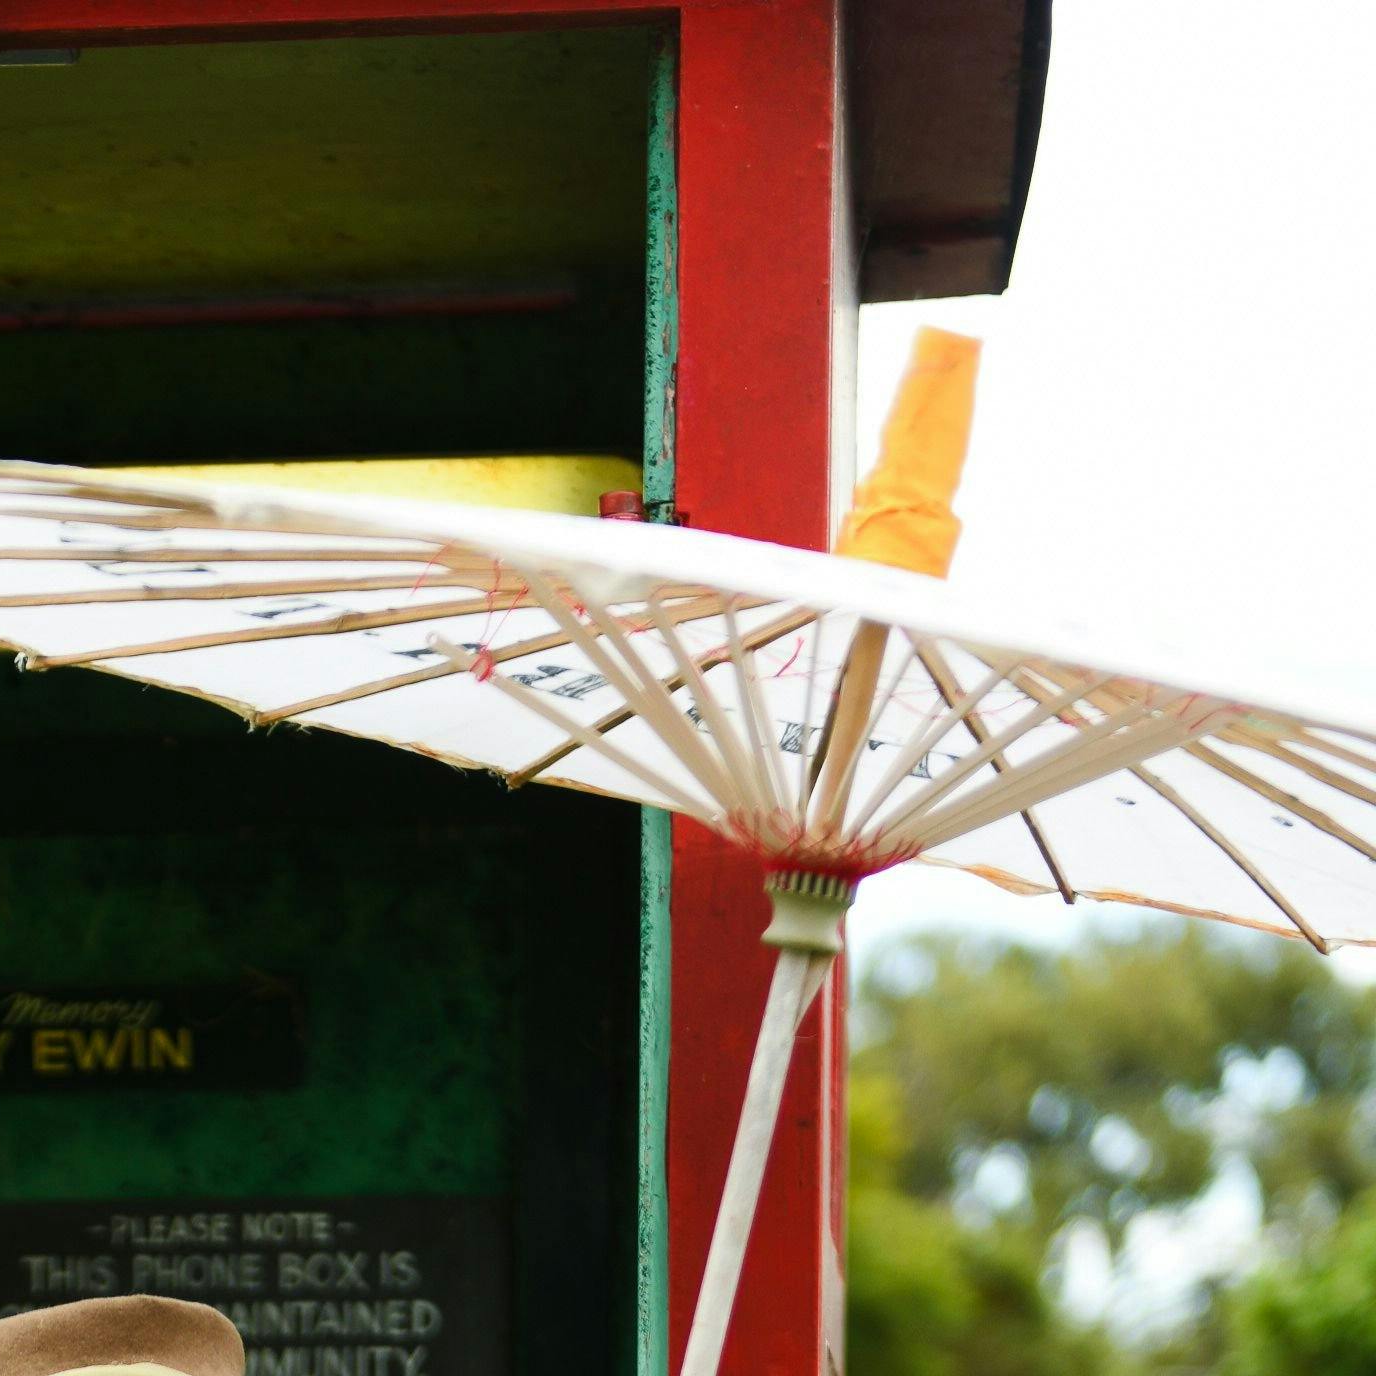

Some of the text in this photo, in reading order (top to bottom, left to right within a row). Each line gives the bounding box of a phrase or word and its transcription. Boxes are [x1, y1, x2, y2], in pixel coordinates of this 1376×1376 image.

[2, 992, 159, 1028] Memory
[32, 1027, 193, 1072] EWIN
[20, 1250, 421, 1293] THIS PHONE BOX IS
[227, 1299, 442, 1338] AINTAINED
